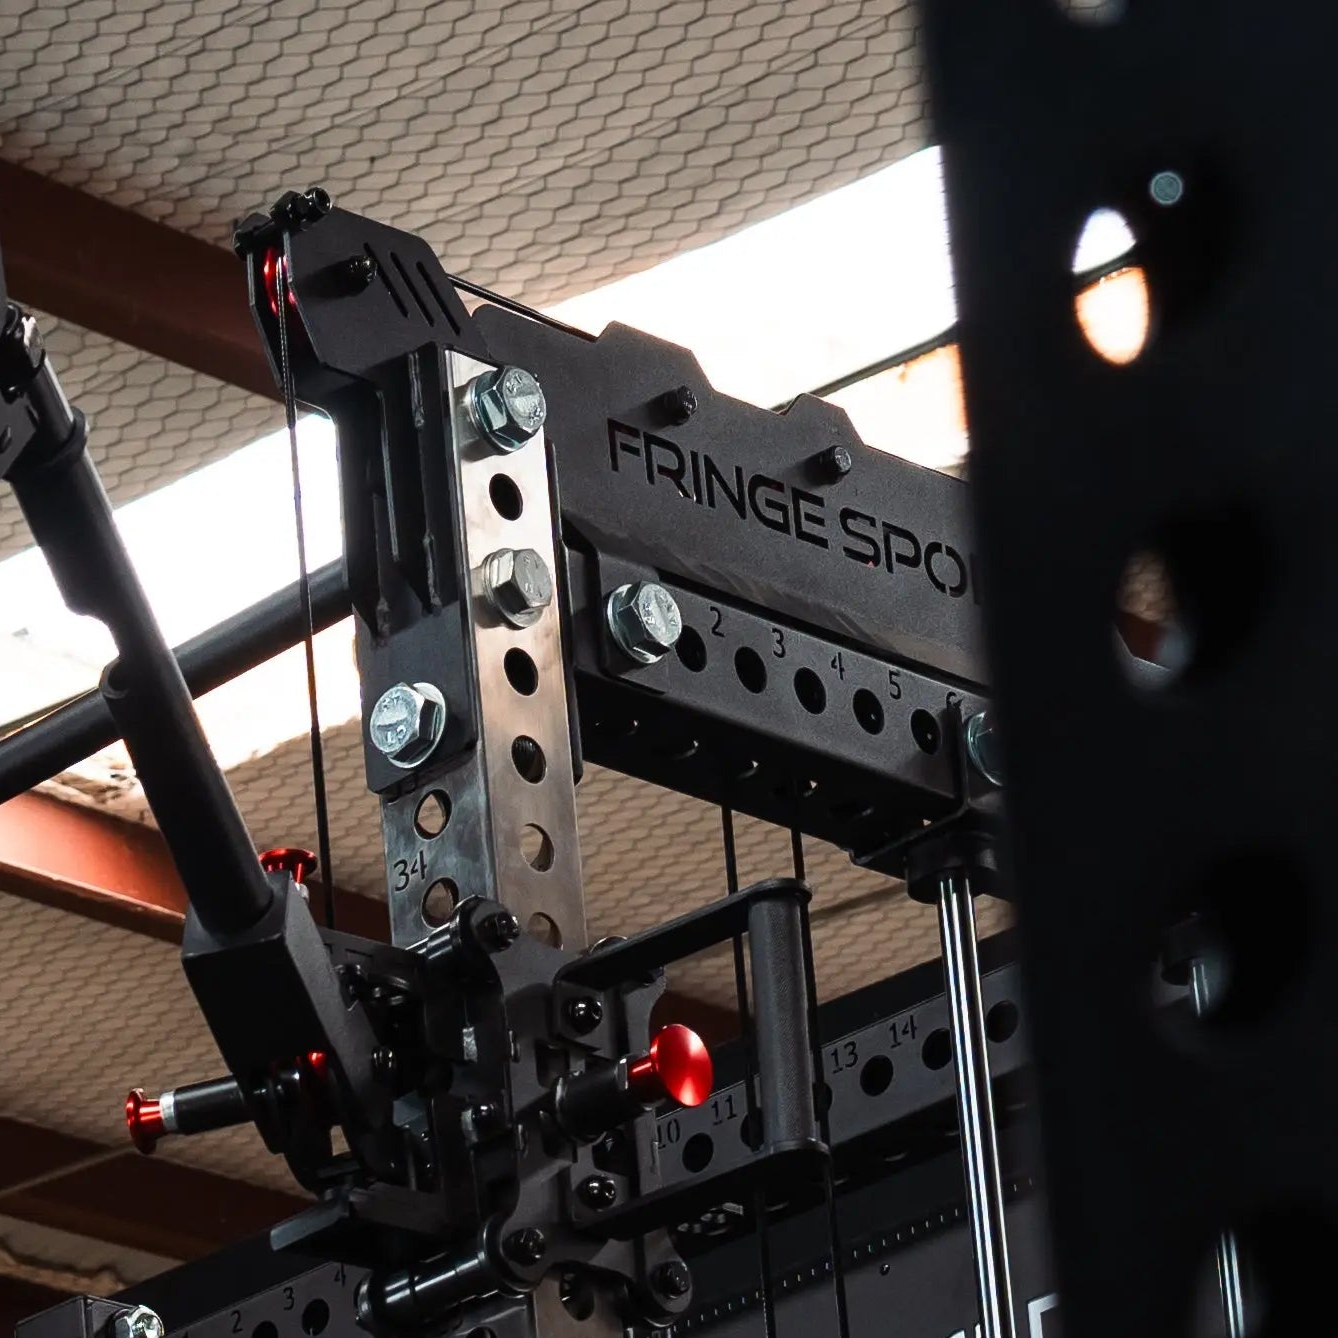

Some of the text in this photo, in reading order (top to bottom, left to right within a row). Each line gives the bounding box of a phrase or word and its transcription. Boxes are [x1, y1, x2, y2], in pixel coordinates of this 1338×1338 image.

[606, 417, 968, 598] FRINGE SPO
[710, 607, 725, 637] 2
[772, 628, 787, 658] 3
[831, 651, 846, 682] 4
[887, 670, 902, 700] 5
[393, 856, 427, 892] 34
[889, 1015, 917, 1047] 14
[830, 1042, 860, 1074] 13
[711, 1095, 736, 1125] 11
[656, 1123, 681, 1153] 10
[334, 1265, 346, 1287] 4
[283, 1287, 295, 1310] 3
[232, 1310, 244, 1333] 2
